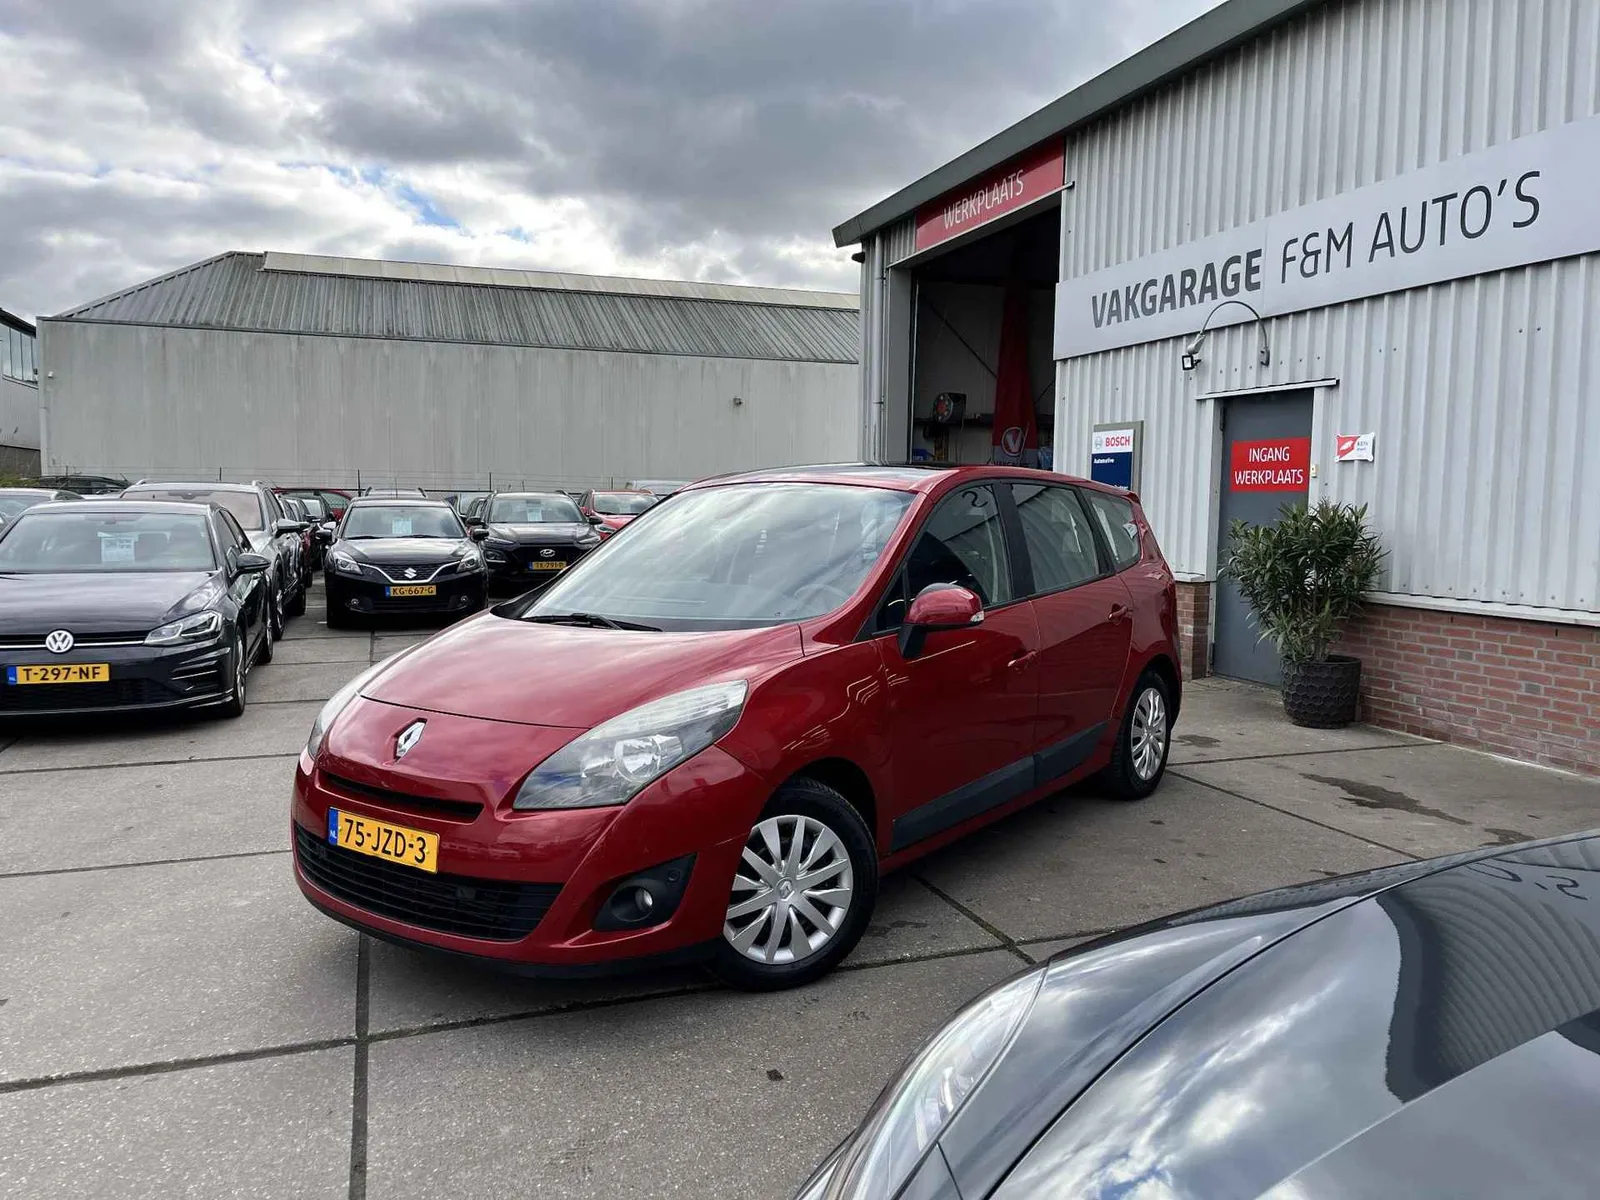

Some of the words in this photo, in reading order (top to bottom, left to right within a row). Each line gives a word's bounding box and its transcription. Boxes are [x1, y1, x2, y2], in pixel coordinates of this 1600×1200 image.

[943, 169, 1025, 230] WERKPLAATS
[1091, 248, 1262, 329] VAKGARAGE
[1280, 222, 1353, 284] F&M
[1368, 170, 1541, 263] AUTO'S
[1105, 436, 1131, 447] BOSCH
[1248, 445, 1290, 463] INGANG
[1234, 468, 1304, 486] WERKPLAATS
[392, 586, 434, 596] KG-667-G
[23, 666, 101, 682] T-297-NF
[344, 817, 427, 864] 75-JZD-3
